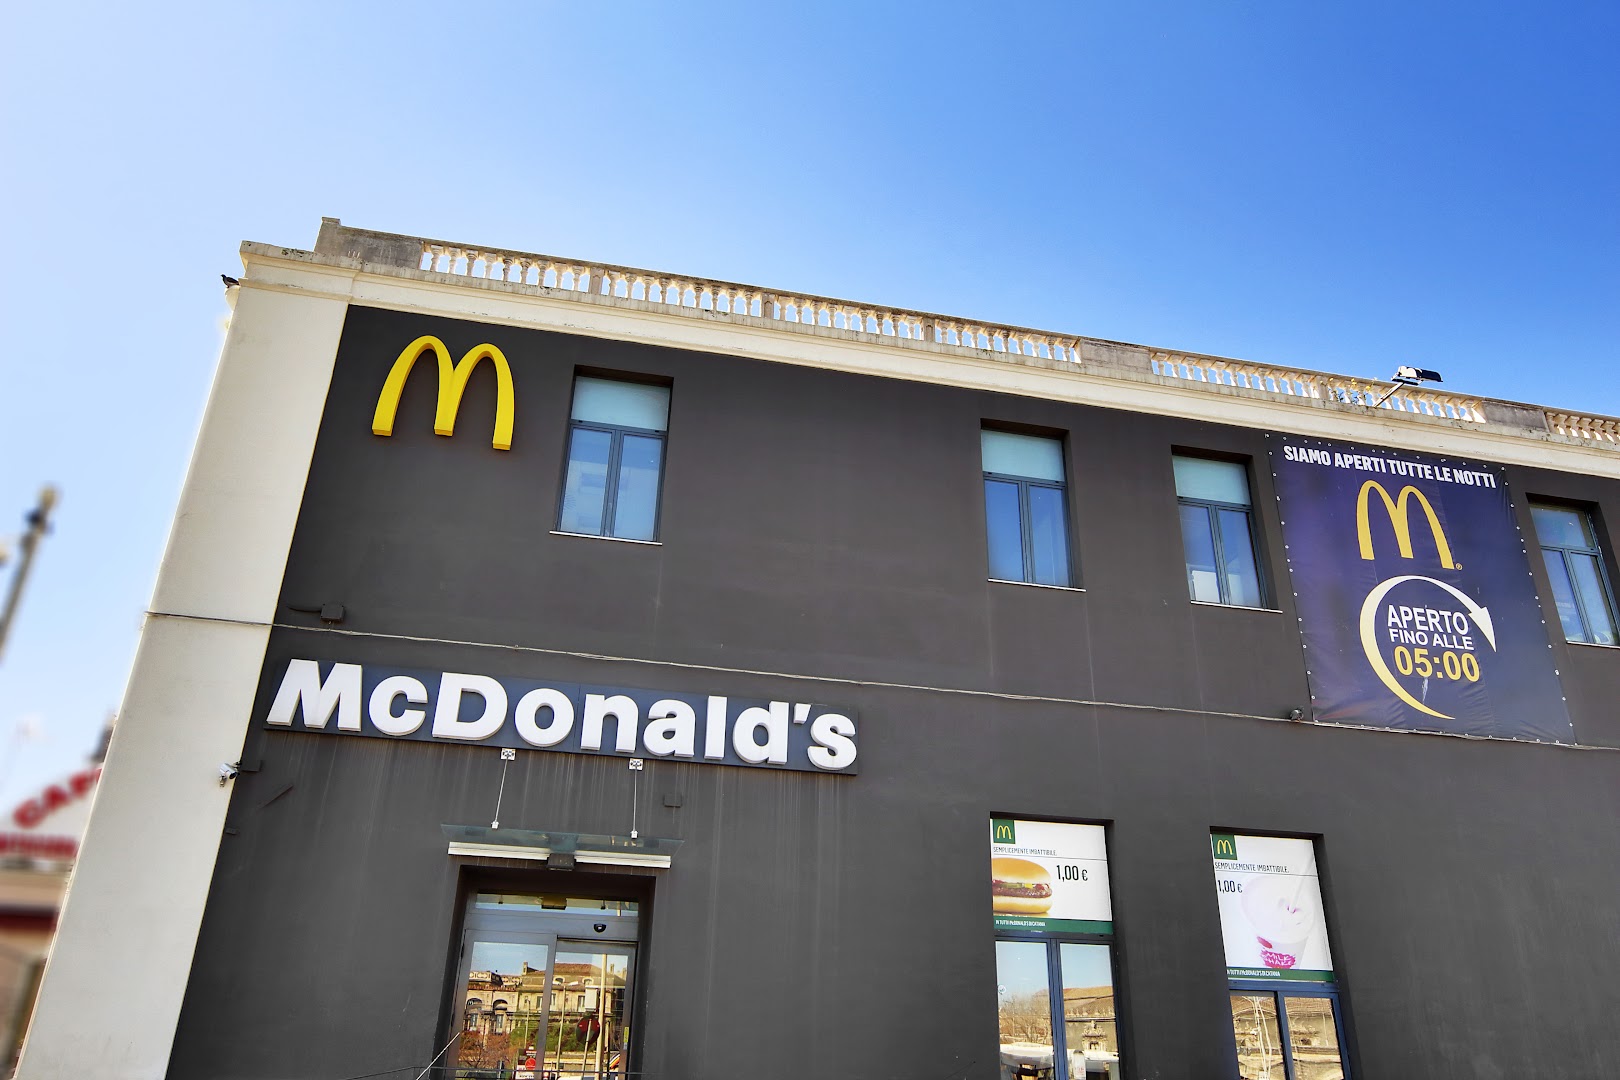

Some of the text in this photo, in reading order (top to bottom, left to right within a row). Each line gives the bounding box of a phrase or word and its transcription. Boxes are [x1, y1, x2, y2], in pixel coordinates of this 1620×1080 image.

[1283, 445, 1497, 489] SIAMO APERTI TUTTE LE NOTTI
[1387, 604, 1469, 635] APERTO
[1389, 628, 1475, 650] FINO ALLE
[1394, 645, 1480, 682] 05:00
[266, 658, 858, 771] McDonald's
[993, 846, 1029, 855] SEMPLICEMENTE
[1056, 864, 1089, 882] 1,00 €
[1214, 862, 1256, 872] SEMPLICEMENTE
[1217, 879, 1236, 894] 1,00
